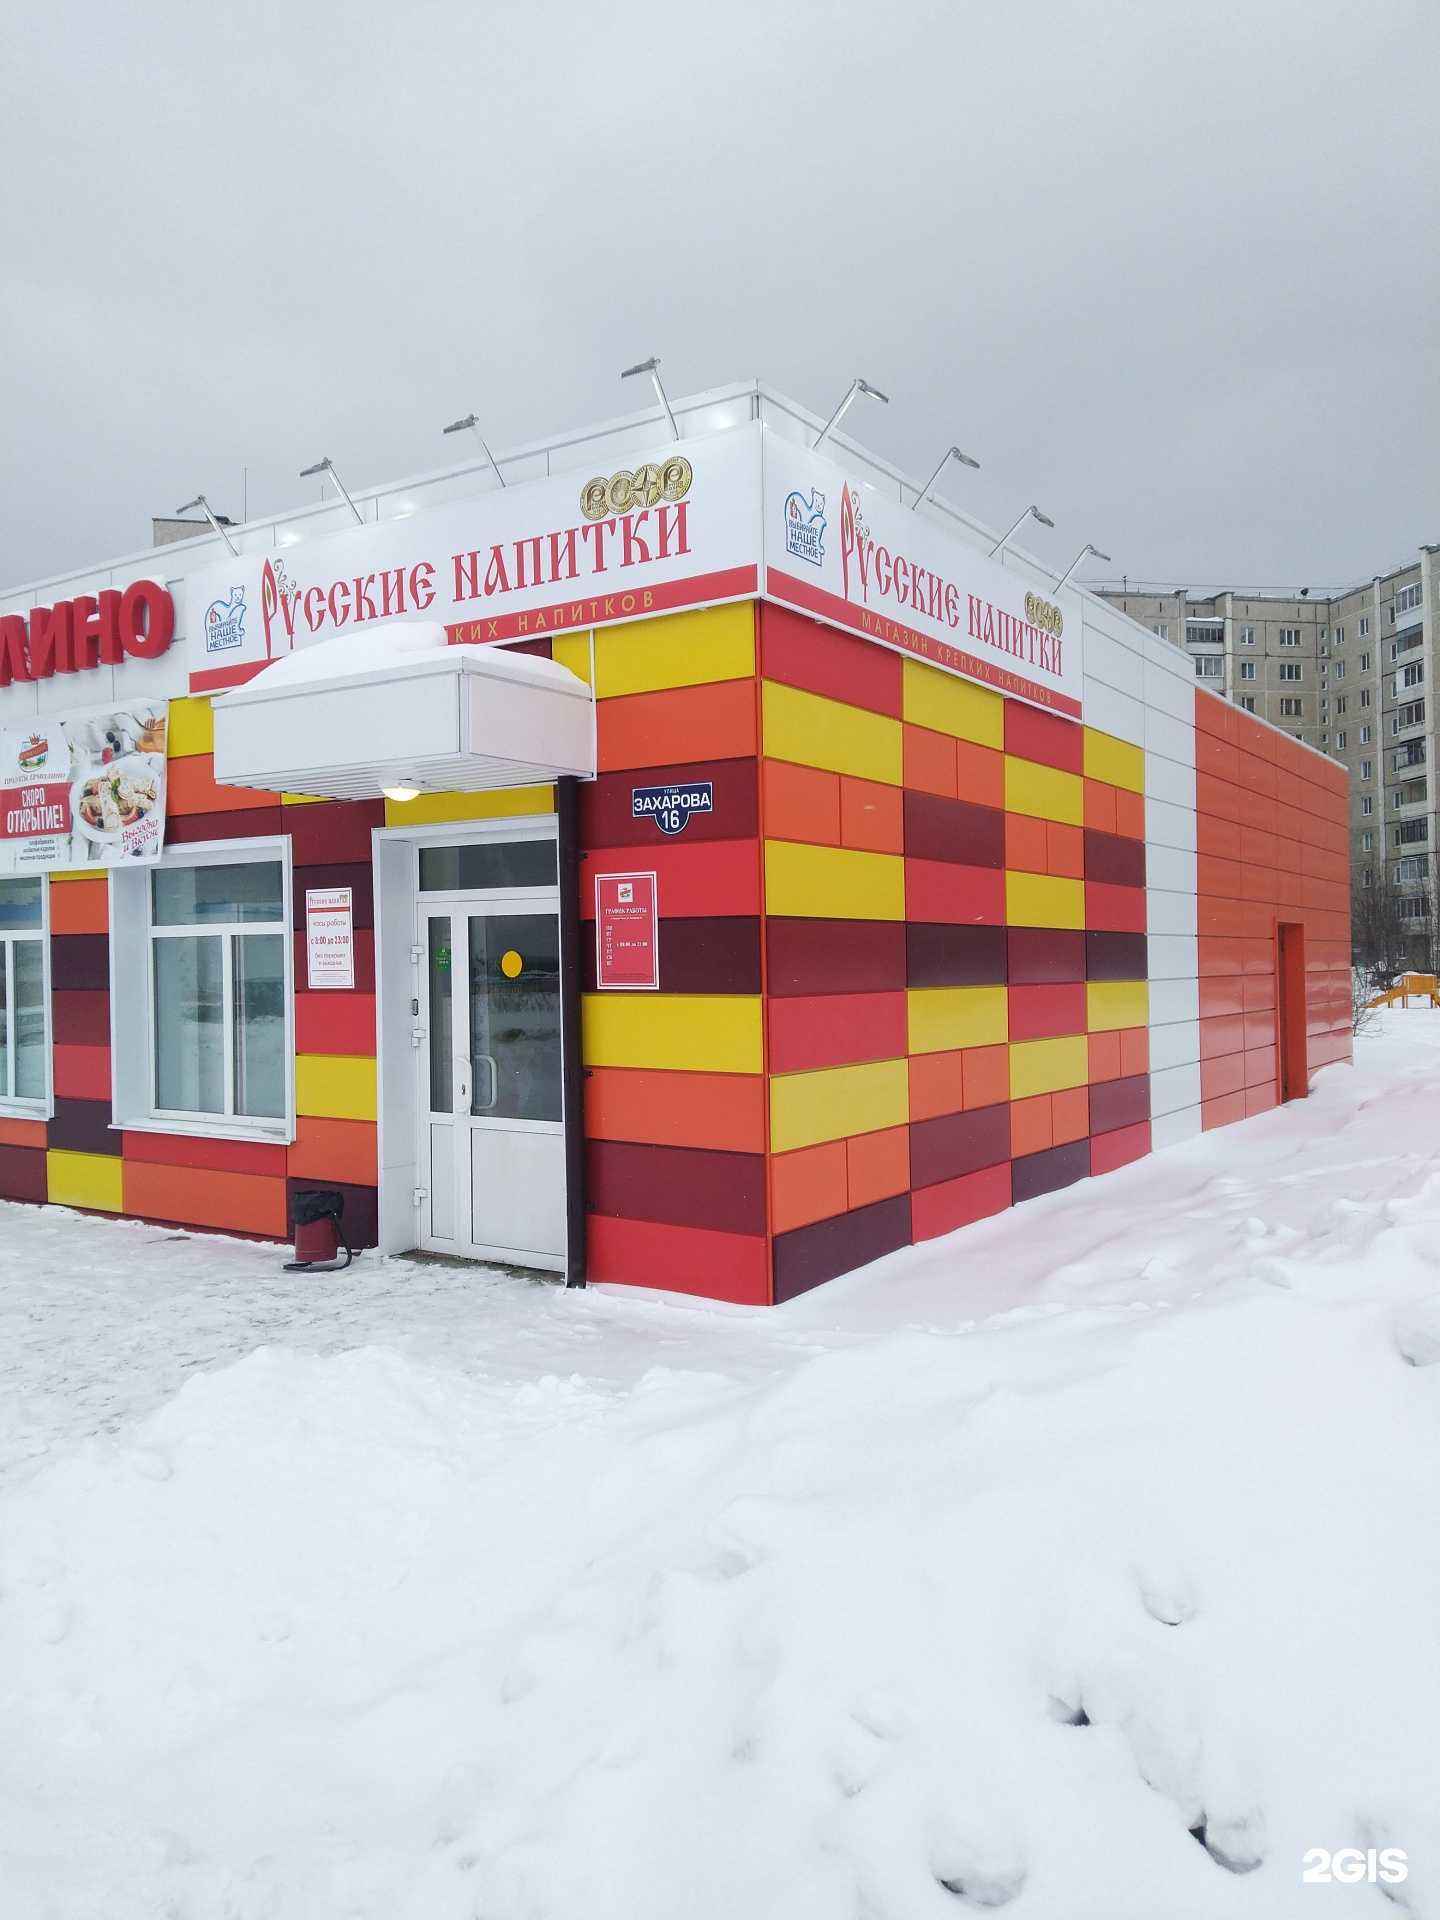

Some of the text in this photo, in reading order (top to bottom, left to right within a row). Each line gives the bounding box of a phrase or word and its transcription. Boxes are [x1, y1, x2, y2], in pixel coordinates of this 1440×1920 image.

[790, 528, 817, 547] НАШЕ
[451, 500, 692, 602] НАПИТКИ
[789, 541, 819, 559] МЕСТНОЕ
[518, 591, 653, 631] НАПИТКОВ
[209, 635, 239, 649] МЕСТНОЕ
[210, 624, 237, 641] НАШЕ
[967, 593, 1063, 677] НАПИТКИ
[860, 611, 1053, 704] МАГАЗИН КРЕПКИХ НАПИТКОВ
[21, 787, 45, 807] СКОРО
[634, 792, 711, 812] ЗАХАРОВА
[7, 804, 64, 833] ОТКРЫТИЕ!
[661, 810, 680, 829] 16
